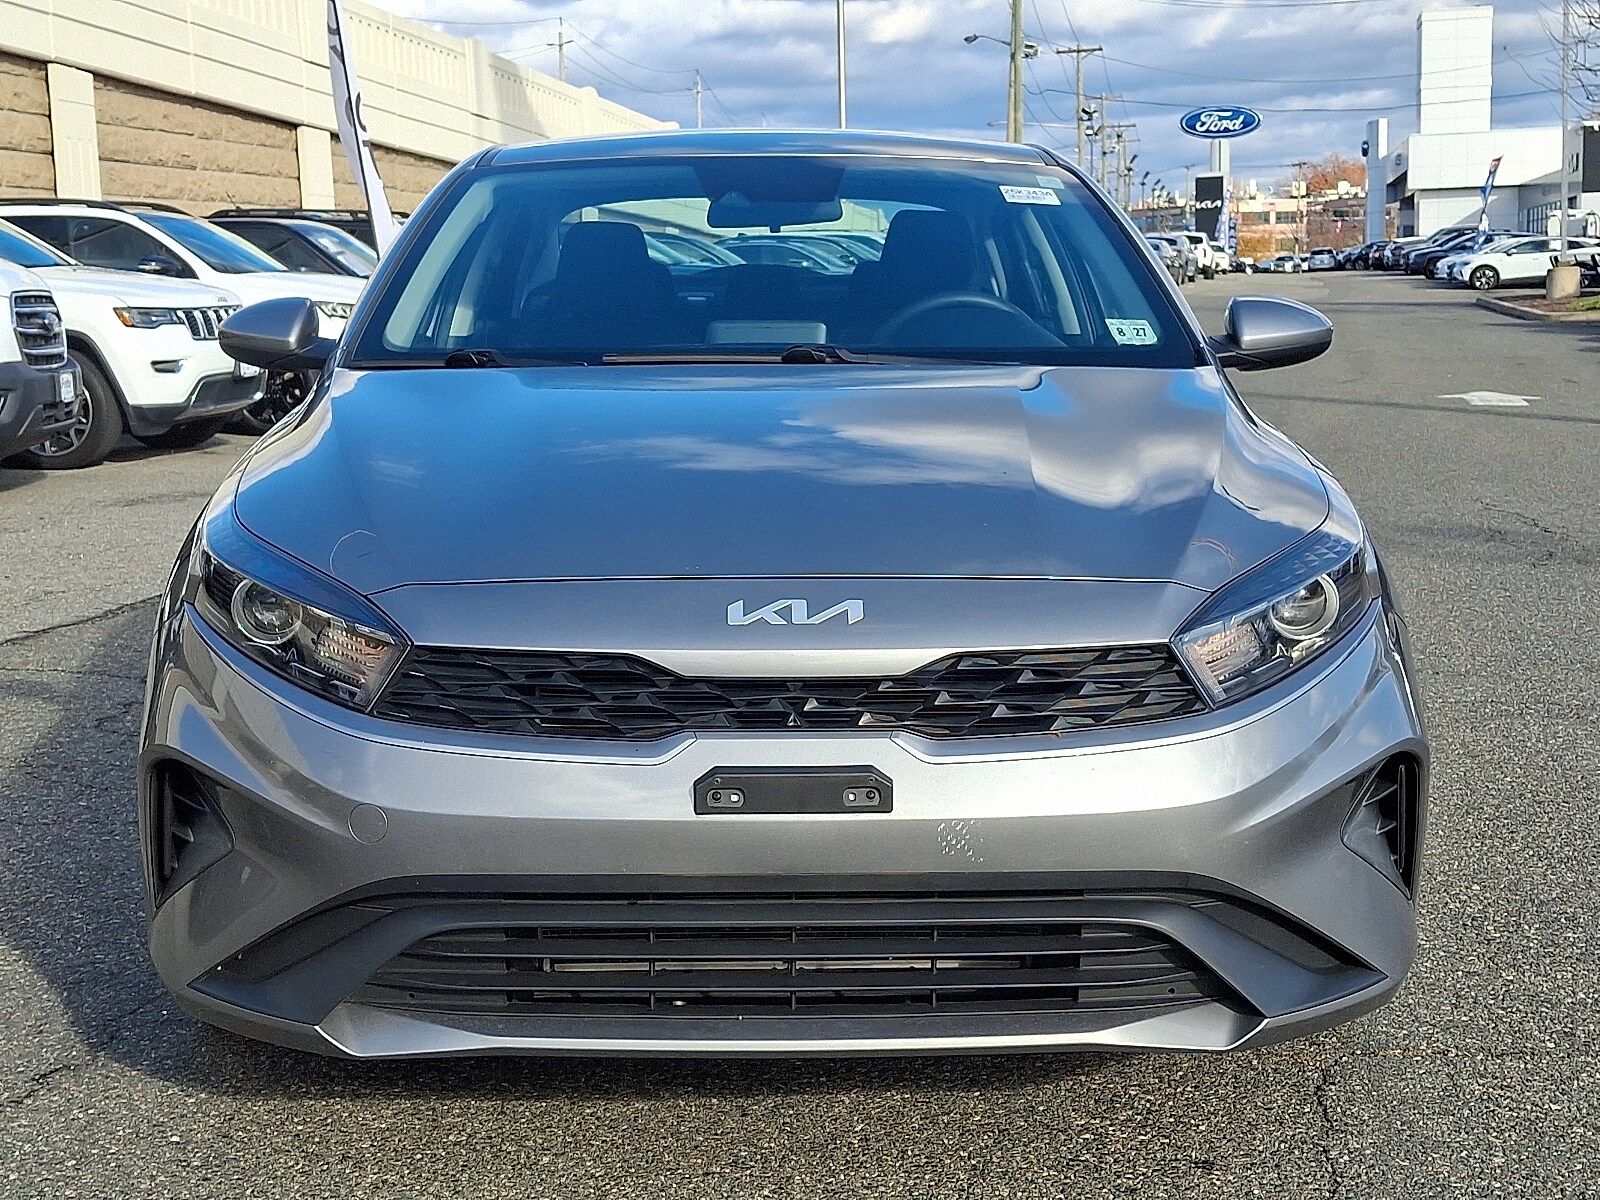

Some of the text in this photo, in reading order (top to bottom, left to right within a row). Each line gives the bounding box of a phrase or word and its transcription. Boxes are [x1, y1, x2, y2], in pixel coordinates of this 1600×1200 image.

[1195, 111, 1245, 131] Ford
[1196, 200, 1222, 209] KIA
[1116, 327, 1147, 337] 8 27
[727, 599, 864, 625] KIA
